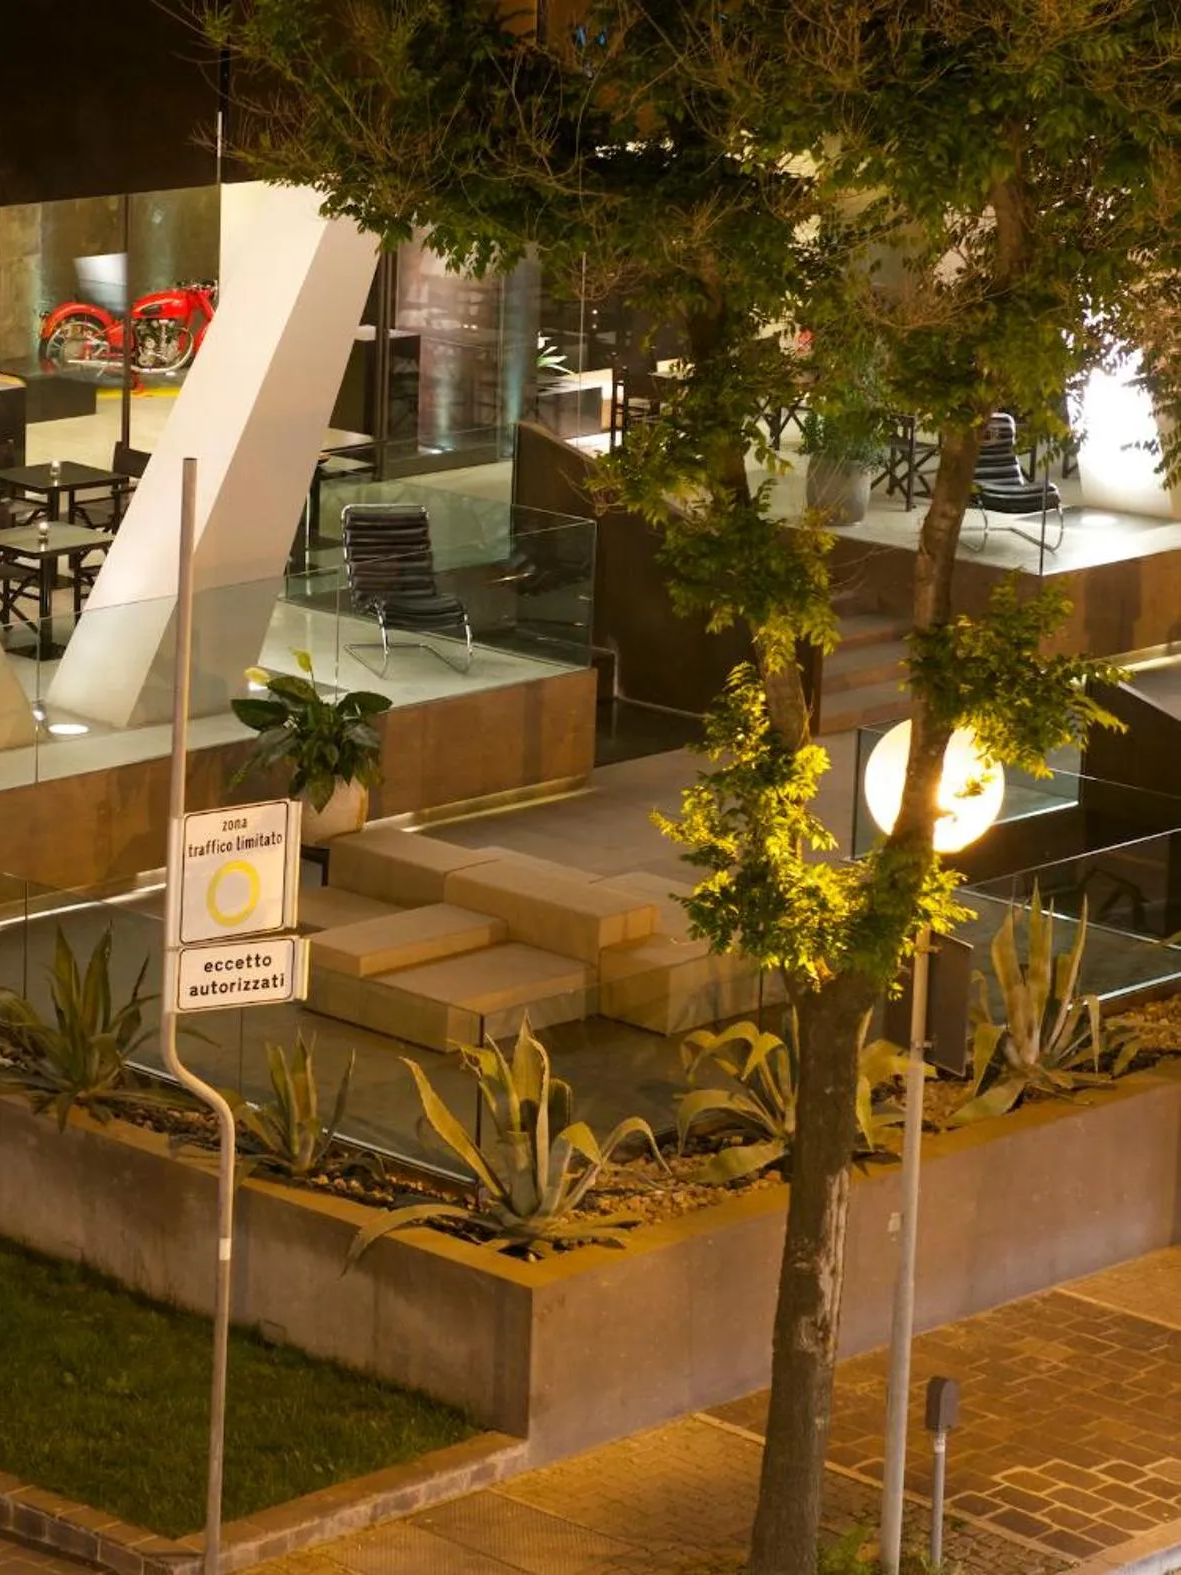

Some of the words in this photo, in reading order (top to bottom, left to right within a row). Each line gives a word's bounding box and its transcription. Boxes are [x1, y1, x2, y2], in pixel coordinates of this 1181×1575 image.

[222, 817, 248, 831] zona
[188, 840, 233, 858] traffico
[236, 832, 283, 851] limitato
[204, 953, 272, 973] eccetto
[189, 973, 285, 997] autorizzati
